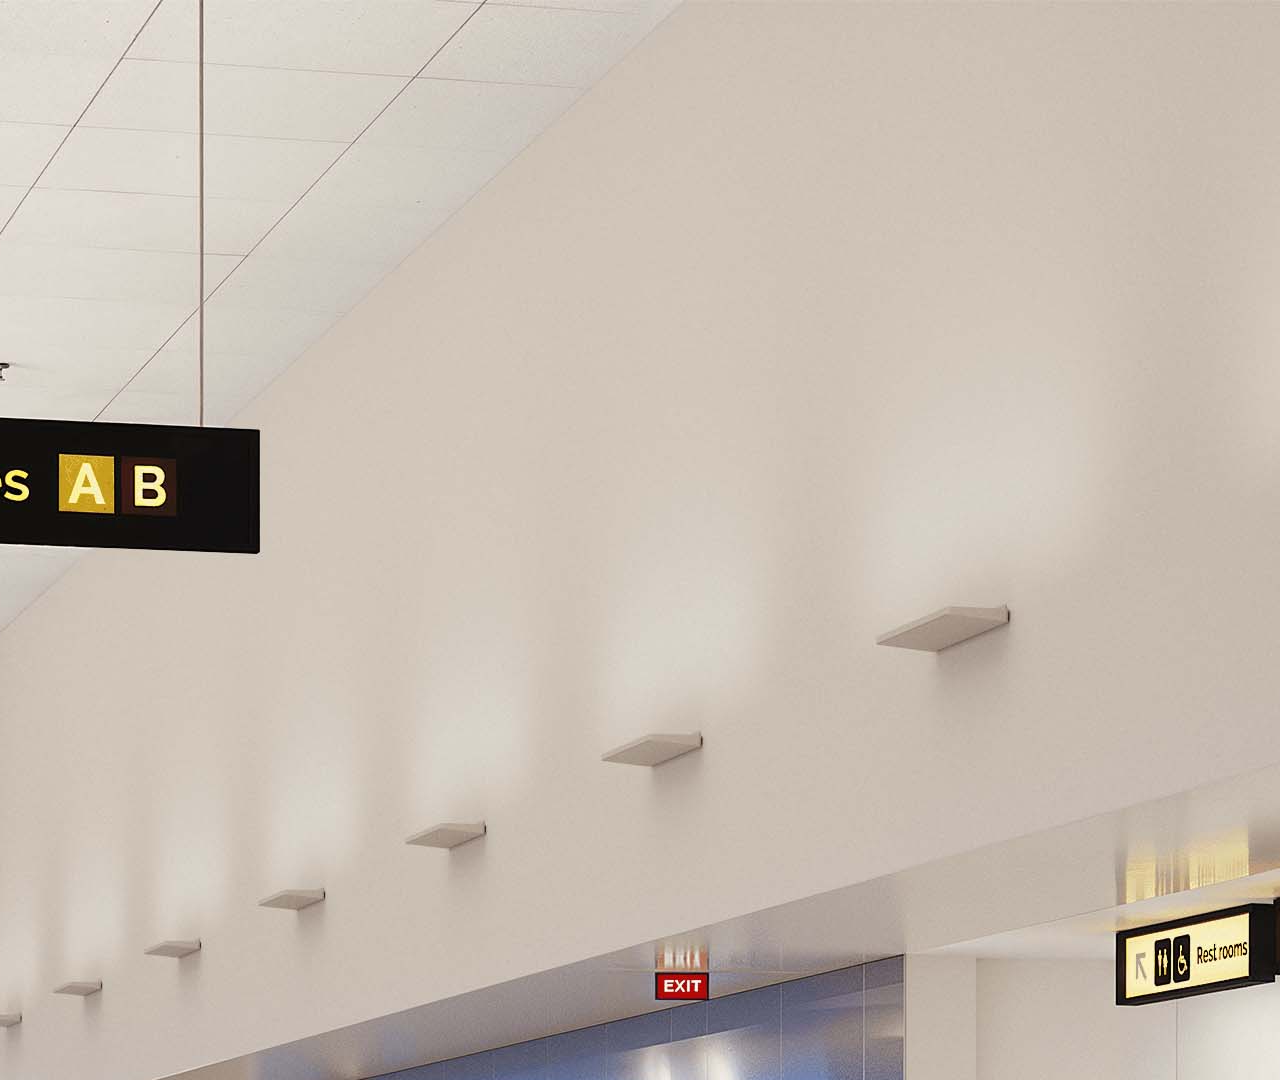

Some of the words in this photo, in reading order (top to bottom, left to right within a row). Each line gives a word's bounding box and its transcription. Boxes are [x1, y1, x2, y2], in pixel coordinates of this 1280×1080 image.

[68, 462, 106, 505] A
[134, 465, 167, 507] B
[1196, 943, 1217, 965] Rest
[1218, 941, 1248, 961] rooms
[664, 979, 702, 992] EXIT
